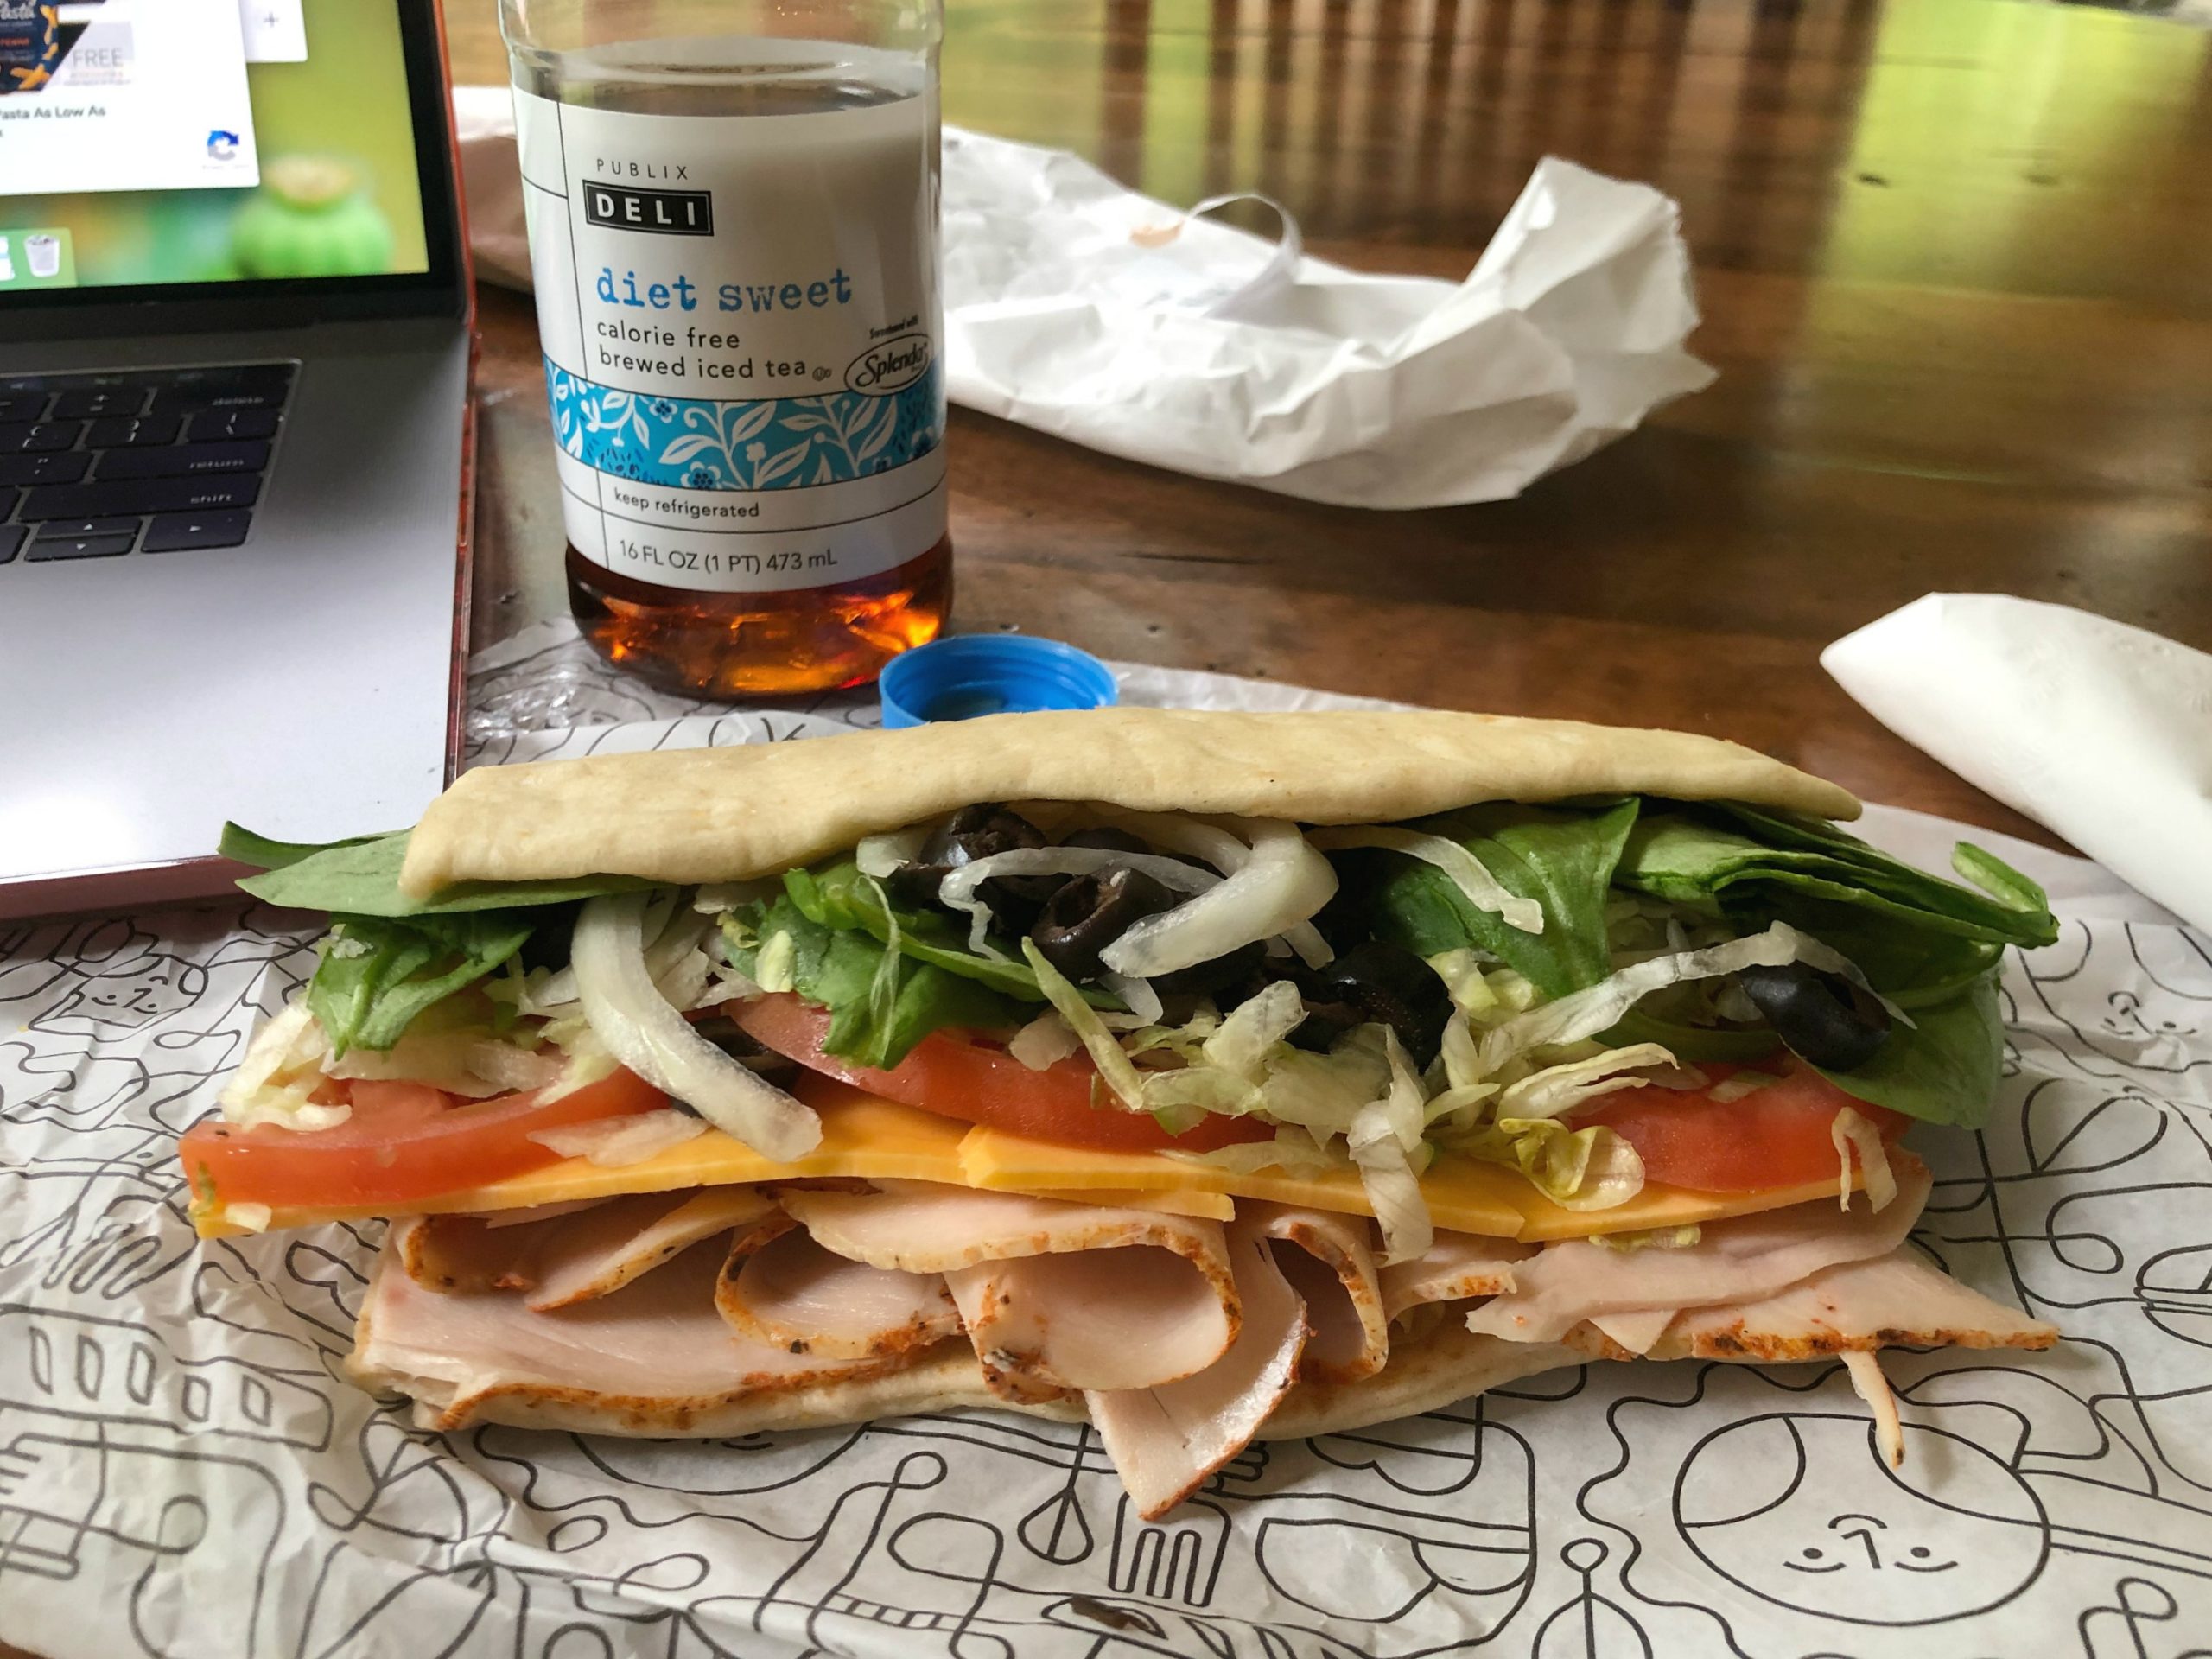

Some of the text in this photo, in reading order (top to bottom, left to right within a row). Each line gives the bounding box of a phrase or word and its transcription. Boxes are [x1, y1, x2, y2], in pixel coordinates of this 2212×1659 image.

[72, 48, 124, 67] FREE
[0, 105, 106, 120] asta As Low As
[596, 158, 689, 180] PUBLIX
[596, 194, 696, 226] DELI
[597, 267, 852, 313] diet sweet
[597, 320, 741, 349] calorie free
[600, 346, 686, 378] brewed
[697, 357, 754, 379] iced
[765, 360, 807, 378] tea
[614, 487, 760, 519] keep refrigerated
[620, 539, 838, 575] 16 FL OZ (1 PT) 473 mL
